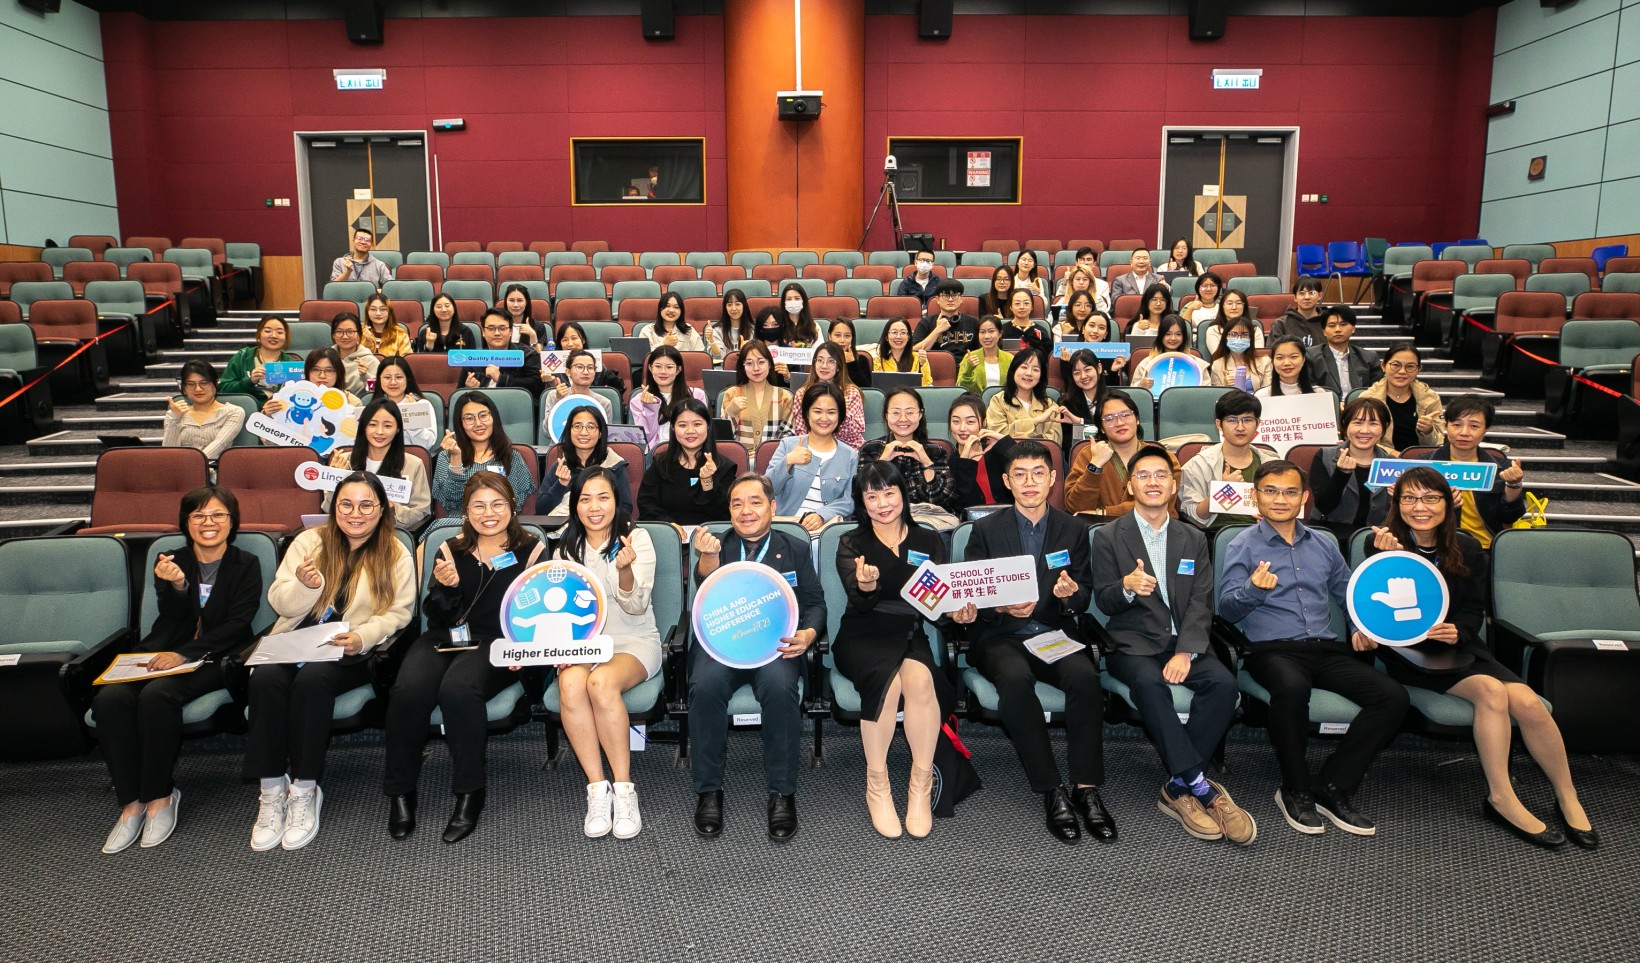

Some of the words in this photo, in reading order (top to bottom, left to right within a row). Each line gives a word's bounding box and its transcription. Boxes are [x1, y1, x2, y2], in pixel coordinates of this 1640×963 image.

[780, 350, 805, 358] Lingnan
[1260, 418, 1290, 427] SCHOOL
[1260, 425, 1301, 433] GRADUATE
[1302, 422, 1336, 431] STUDIES
[253, 421, 290, 442] ChatGPT
[1261, 432, 1304, 443] 研究生院
[1444, 472, 1458, 480] to
[1462, 472, 1481, 481] LU
[950, 569, 983, 579] SCHOOL
[984, 567, 995, 576] OF
[951, 577, 995, 588] GRADUATE
[996, 572, 1030, 583] STUDIES
[952, 585, 998, 599] 研究生院
[703, 605, 729, 621] CHINA
[730, 596, 747, 608] AND
[706, 612, 735, 628] HIGHER
[736, 589, 782, 616] EDUCATION
[709, 608, 761, 636] CONFERENCE
[502, 648, 541, 661] Higher
[543, 646, 602, 658] Education
